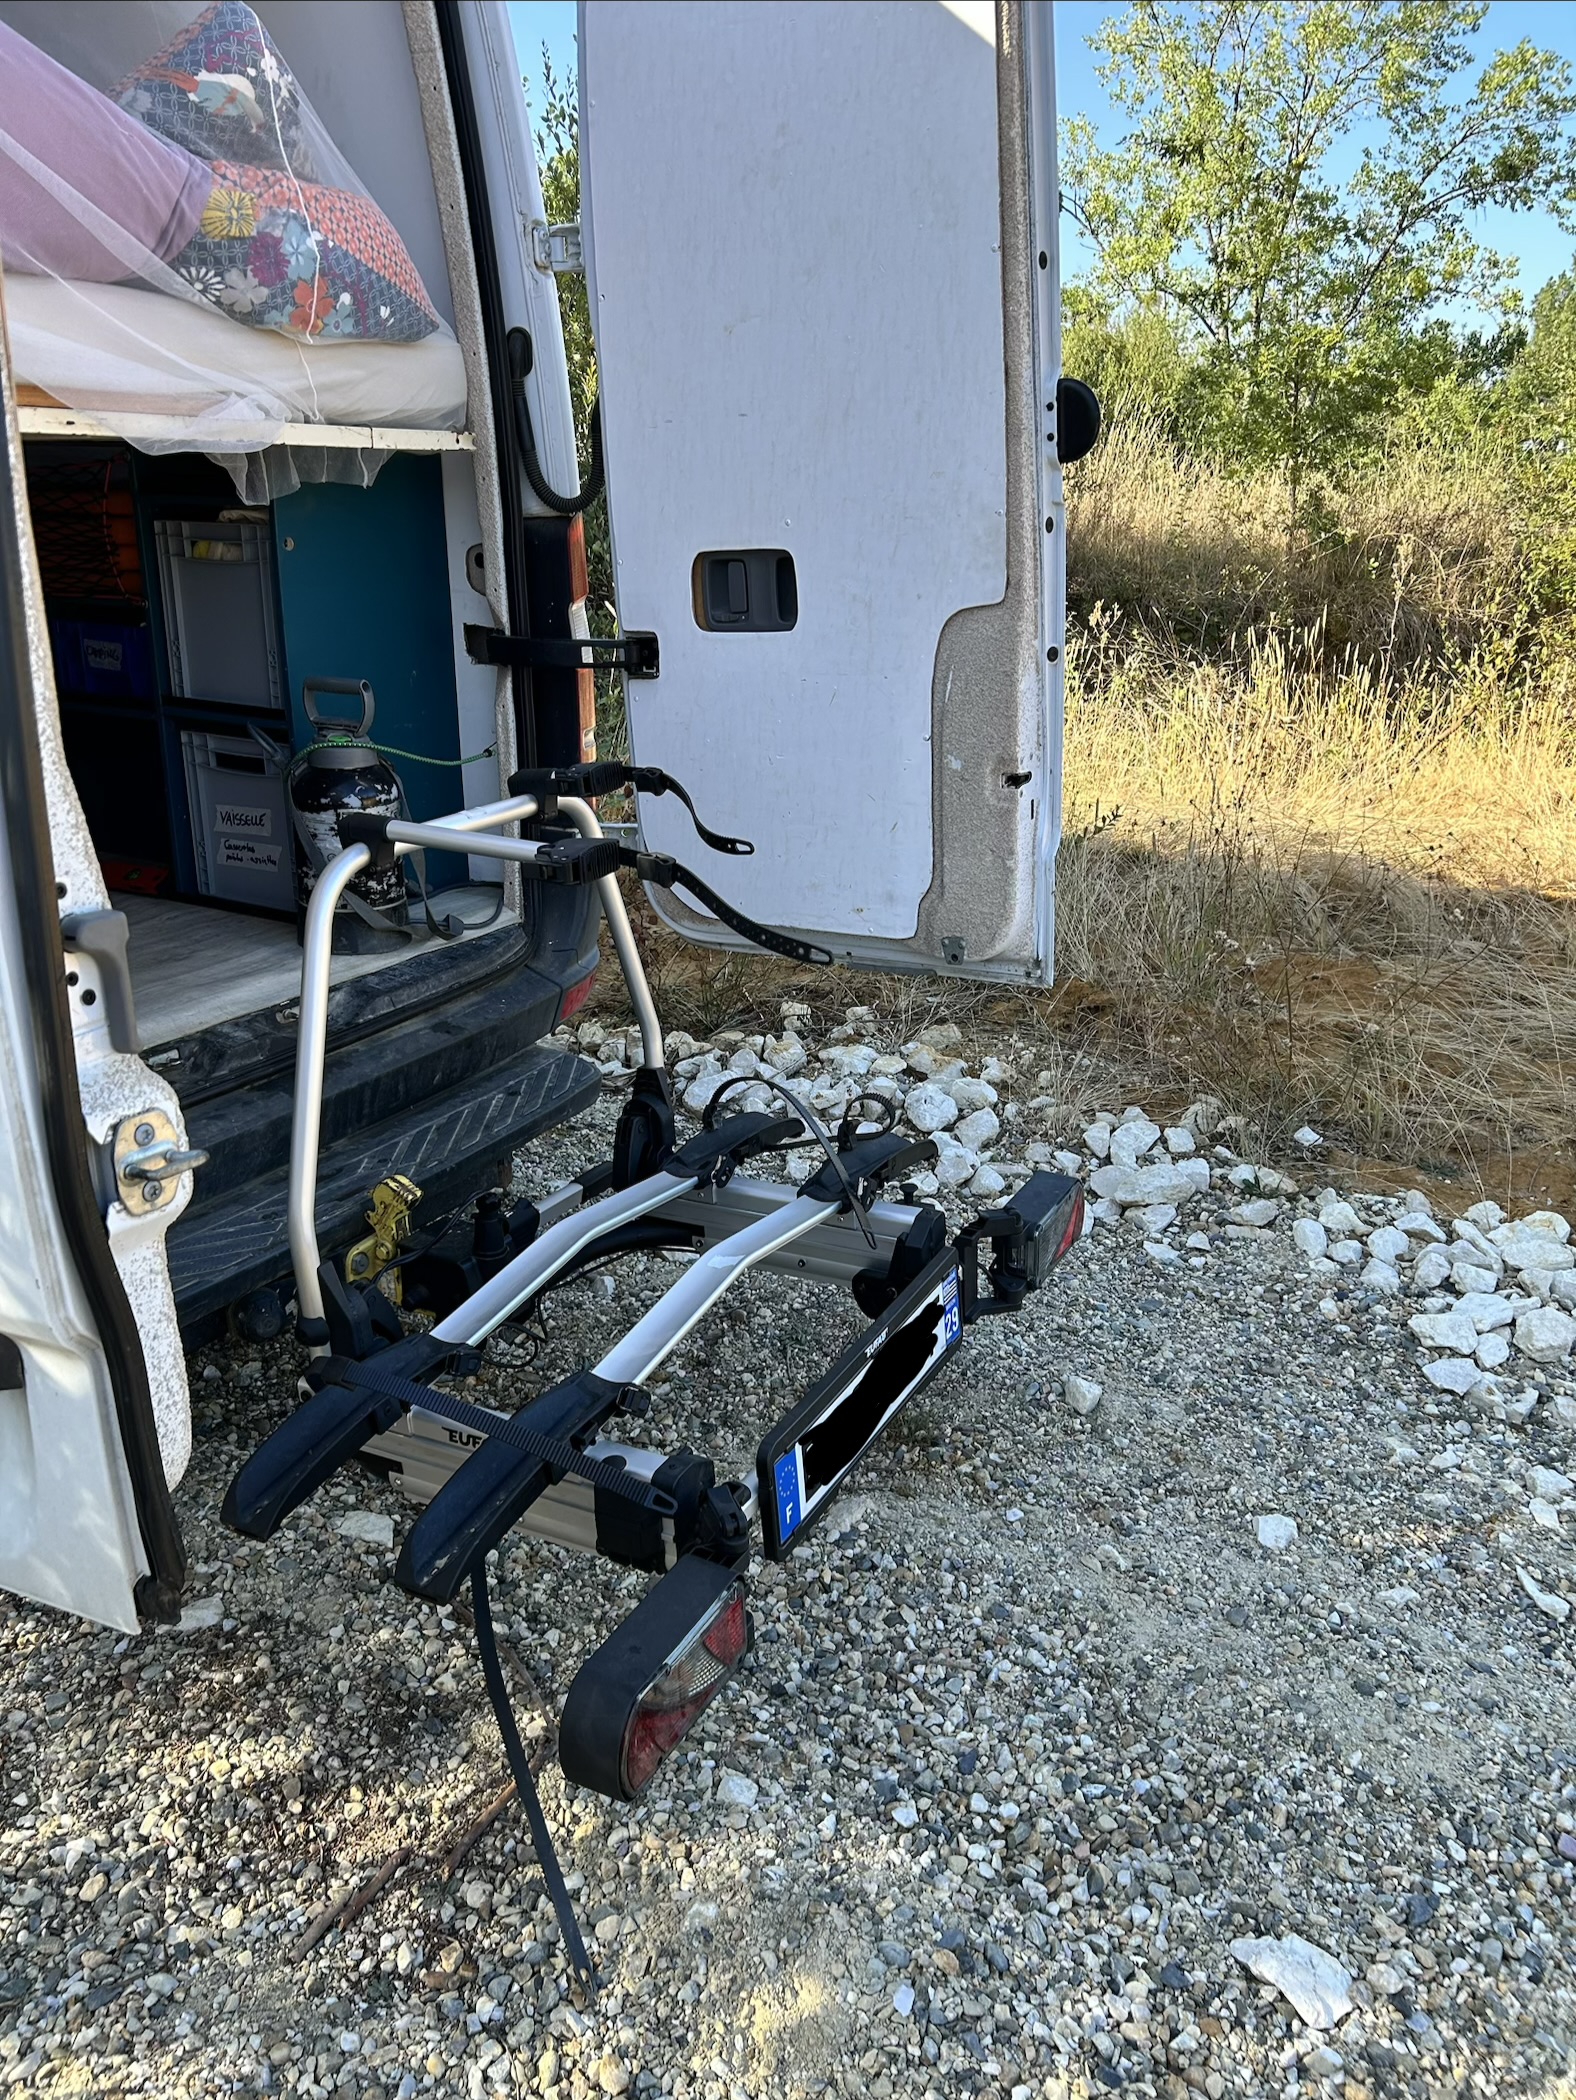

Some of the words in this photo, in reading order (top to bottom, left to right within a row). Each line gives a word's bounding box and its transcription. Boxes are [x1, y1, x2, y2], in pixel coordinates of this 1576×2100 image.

[945, 1306, 959, 1340] 29
[441, 1426, 483, 1448] EUF
[785, 1501, 793, 1524] F
